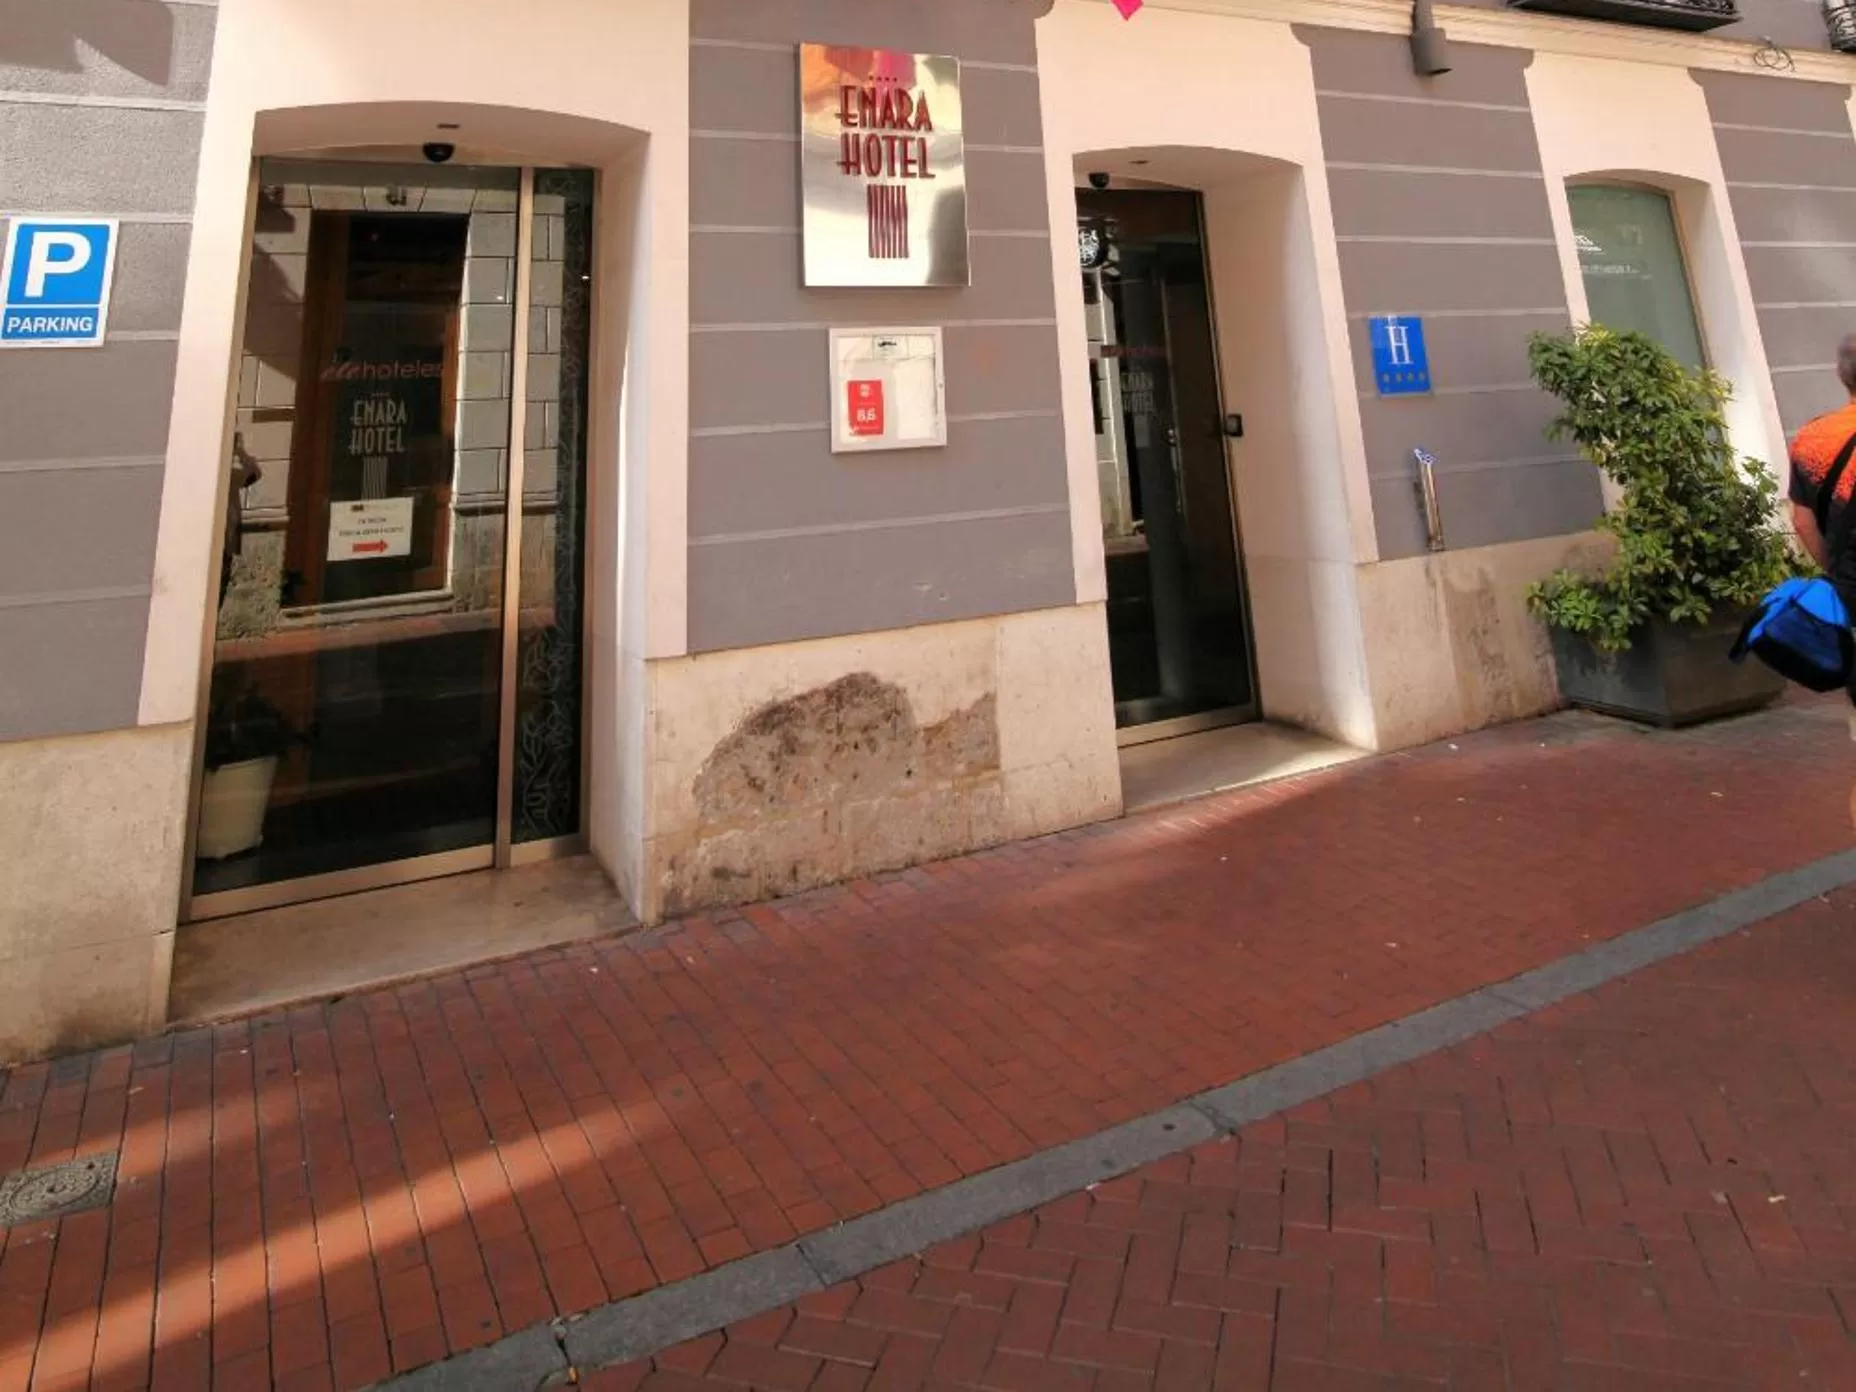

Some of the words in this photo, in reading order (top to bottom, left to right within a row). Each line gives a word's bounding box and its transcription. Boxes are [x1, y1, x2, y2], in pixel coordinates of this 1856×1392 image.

[835, 84, 933, 132] ENARA
[837, 133, 936, 180] HOTEL
[24, 231, 92, 298] P
[7, 316, 94, 333] PARKING
[350, 398, 408, 426] ENARA
[348, 426, 407, 455] HOTEL
